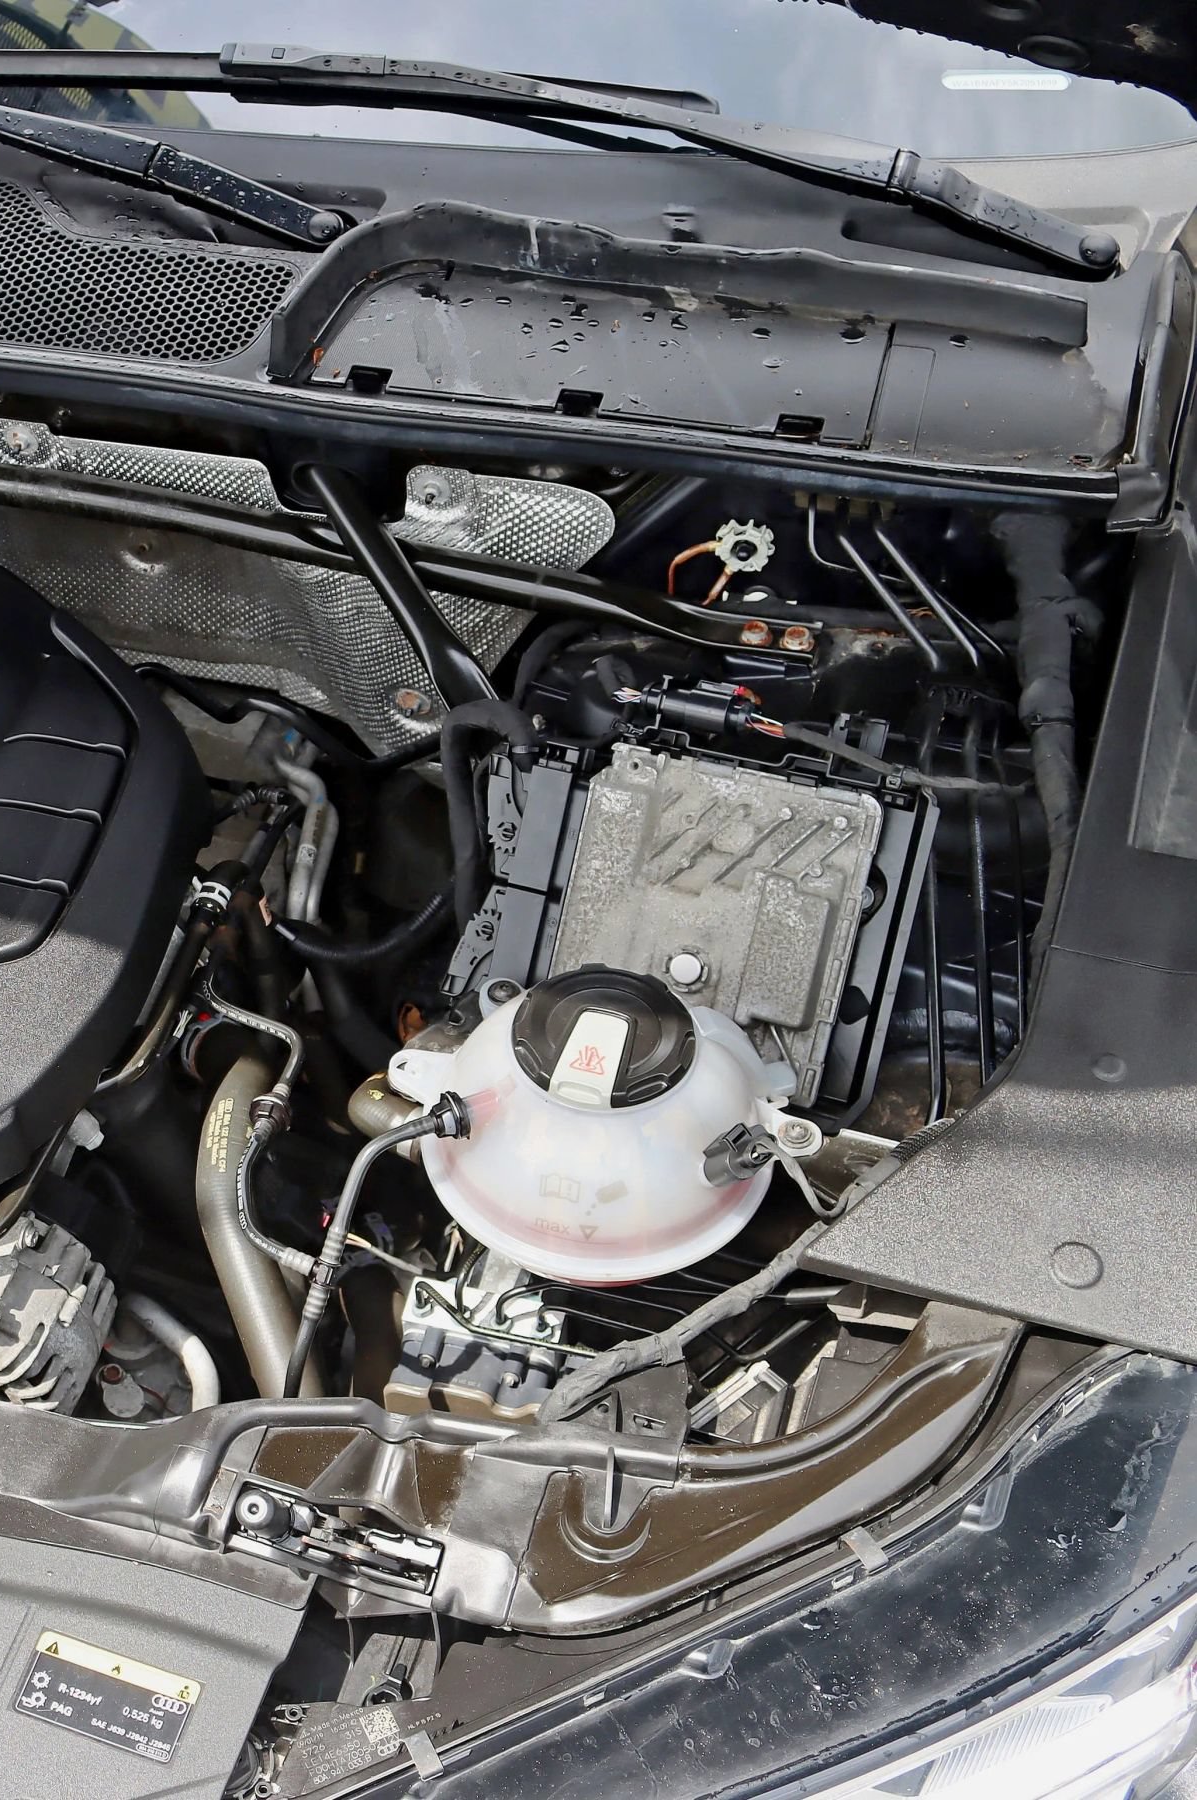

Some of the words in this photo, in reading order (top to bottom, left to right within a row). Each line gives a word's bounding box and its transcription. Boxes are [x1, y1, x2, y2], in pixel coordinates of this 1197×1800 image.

[534, 1216, 571, 1236] max
[50, 1701, 73, 1717] PAG
[58, 1683, 102, 1706] R-1234yf
[123, 1706, 150, 1723] 0,525
[150, 1715, 164, 1729] kg
[91, 1718, 107, 1729] SAE
[311, 1721, 330, 1732] Made
[338, 1707, 364, 1721] Mexico
[302, 1744, 325, 1758] 3726
